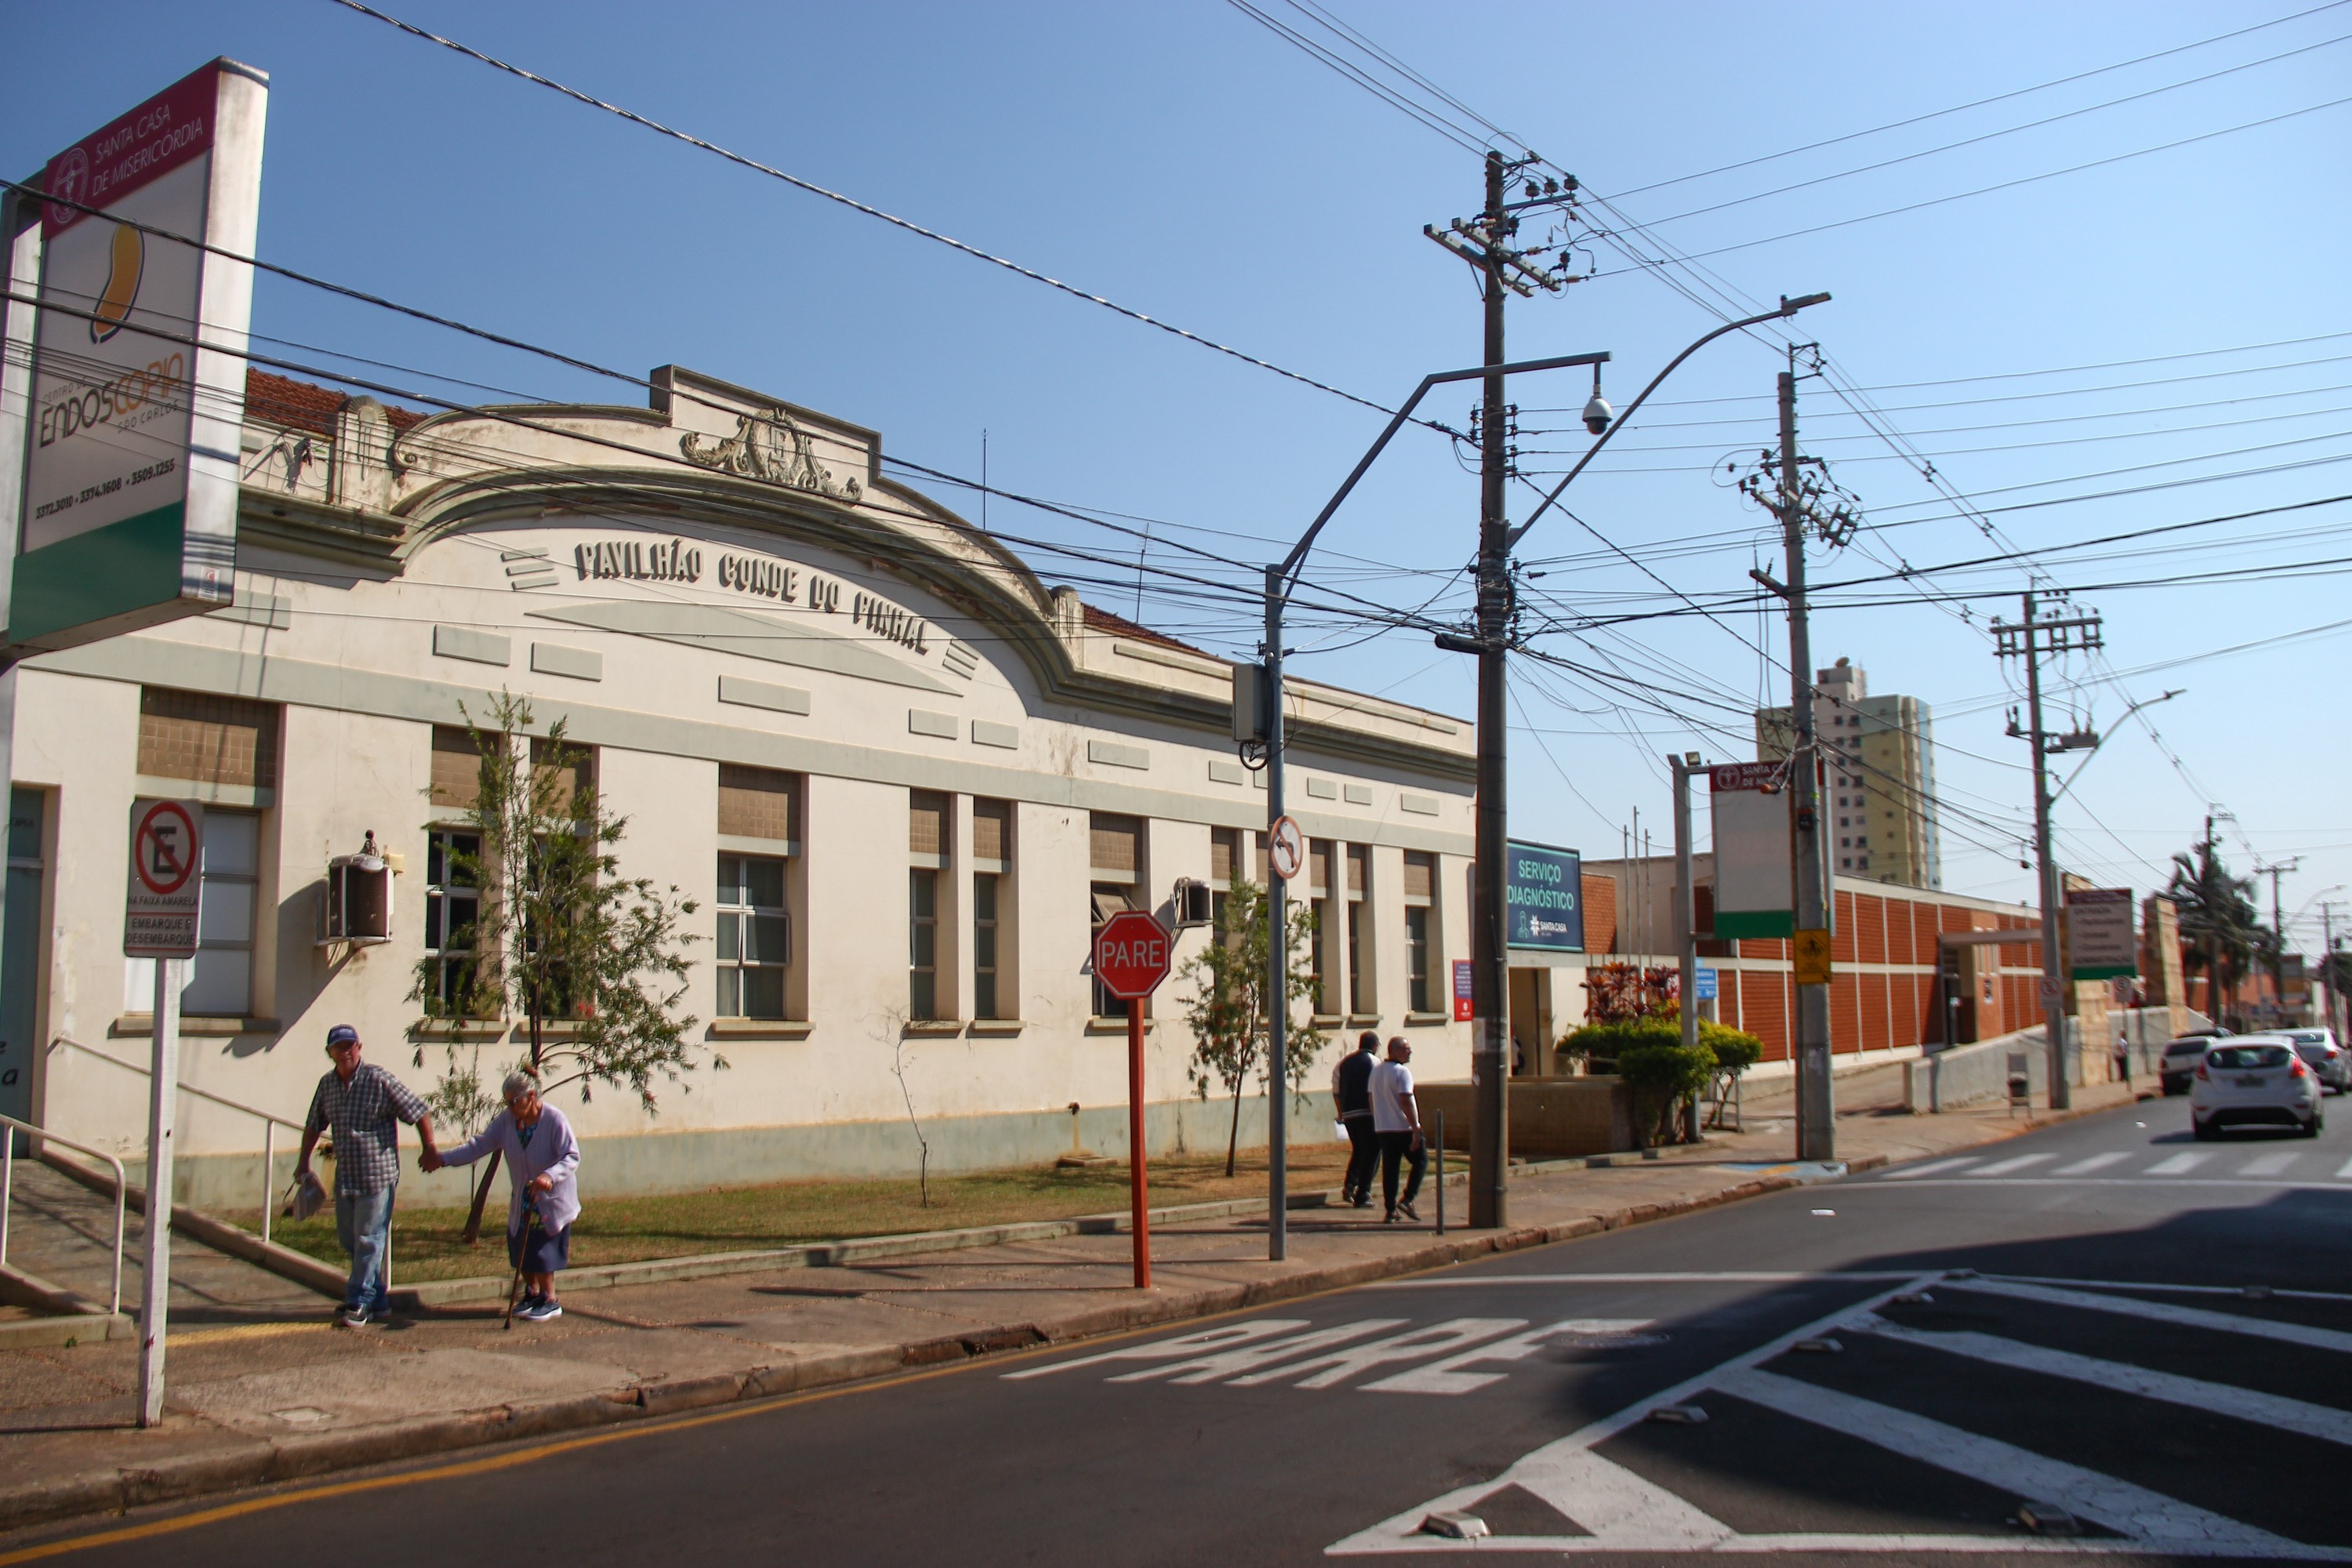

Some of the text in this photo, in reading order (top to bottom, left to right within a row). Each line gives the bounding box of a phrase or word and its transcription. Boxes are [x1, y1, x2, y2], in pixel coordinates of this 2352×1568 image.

[96, 103, 171, 163] SANTA CASA
[93, 169, 110, 196] DE
[111, 117, 204, 185] MISERICÓRDIA
[40, 352, 184, 448] ENDOSCOPIA
[141, 399, 180, 423] CARLOS
[35, 458, 176, 519] 3372.3010 3374.1608 3509.1255
[719, 551, 800, 602] CONDE
[809, 574, 842, 612] DO
[852, 590, 930, 655] PINHAL
[1519, 859, 1562, 886] SERVIÇO
[139, 896, 160, 906] FAIXA
[162, 896, 198, 906] AMARELA
[1507, 884, 1574, 910] DIAGNÓSTICO
[132, 917, 183, 930] EMBARQUE
[1540, 920, 1567, 932] SANTA CASA
[125, 932, 195, 946] DESEMBARQUE
[1102, 940, 1163, 968] PARE
